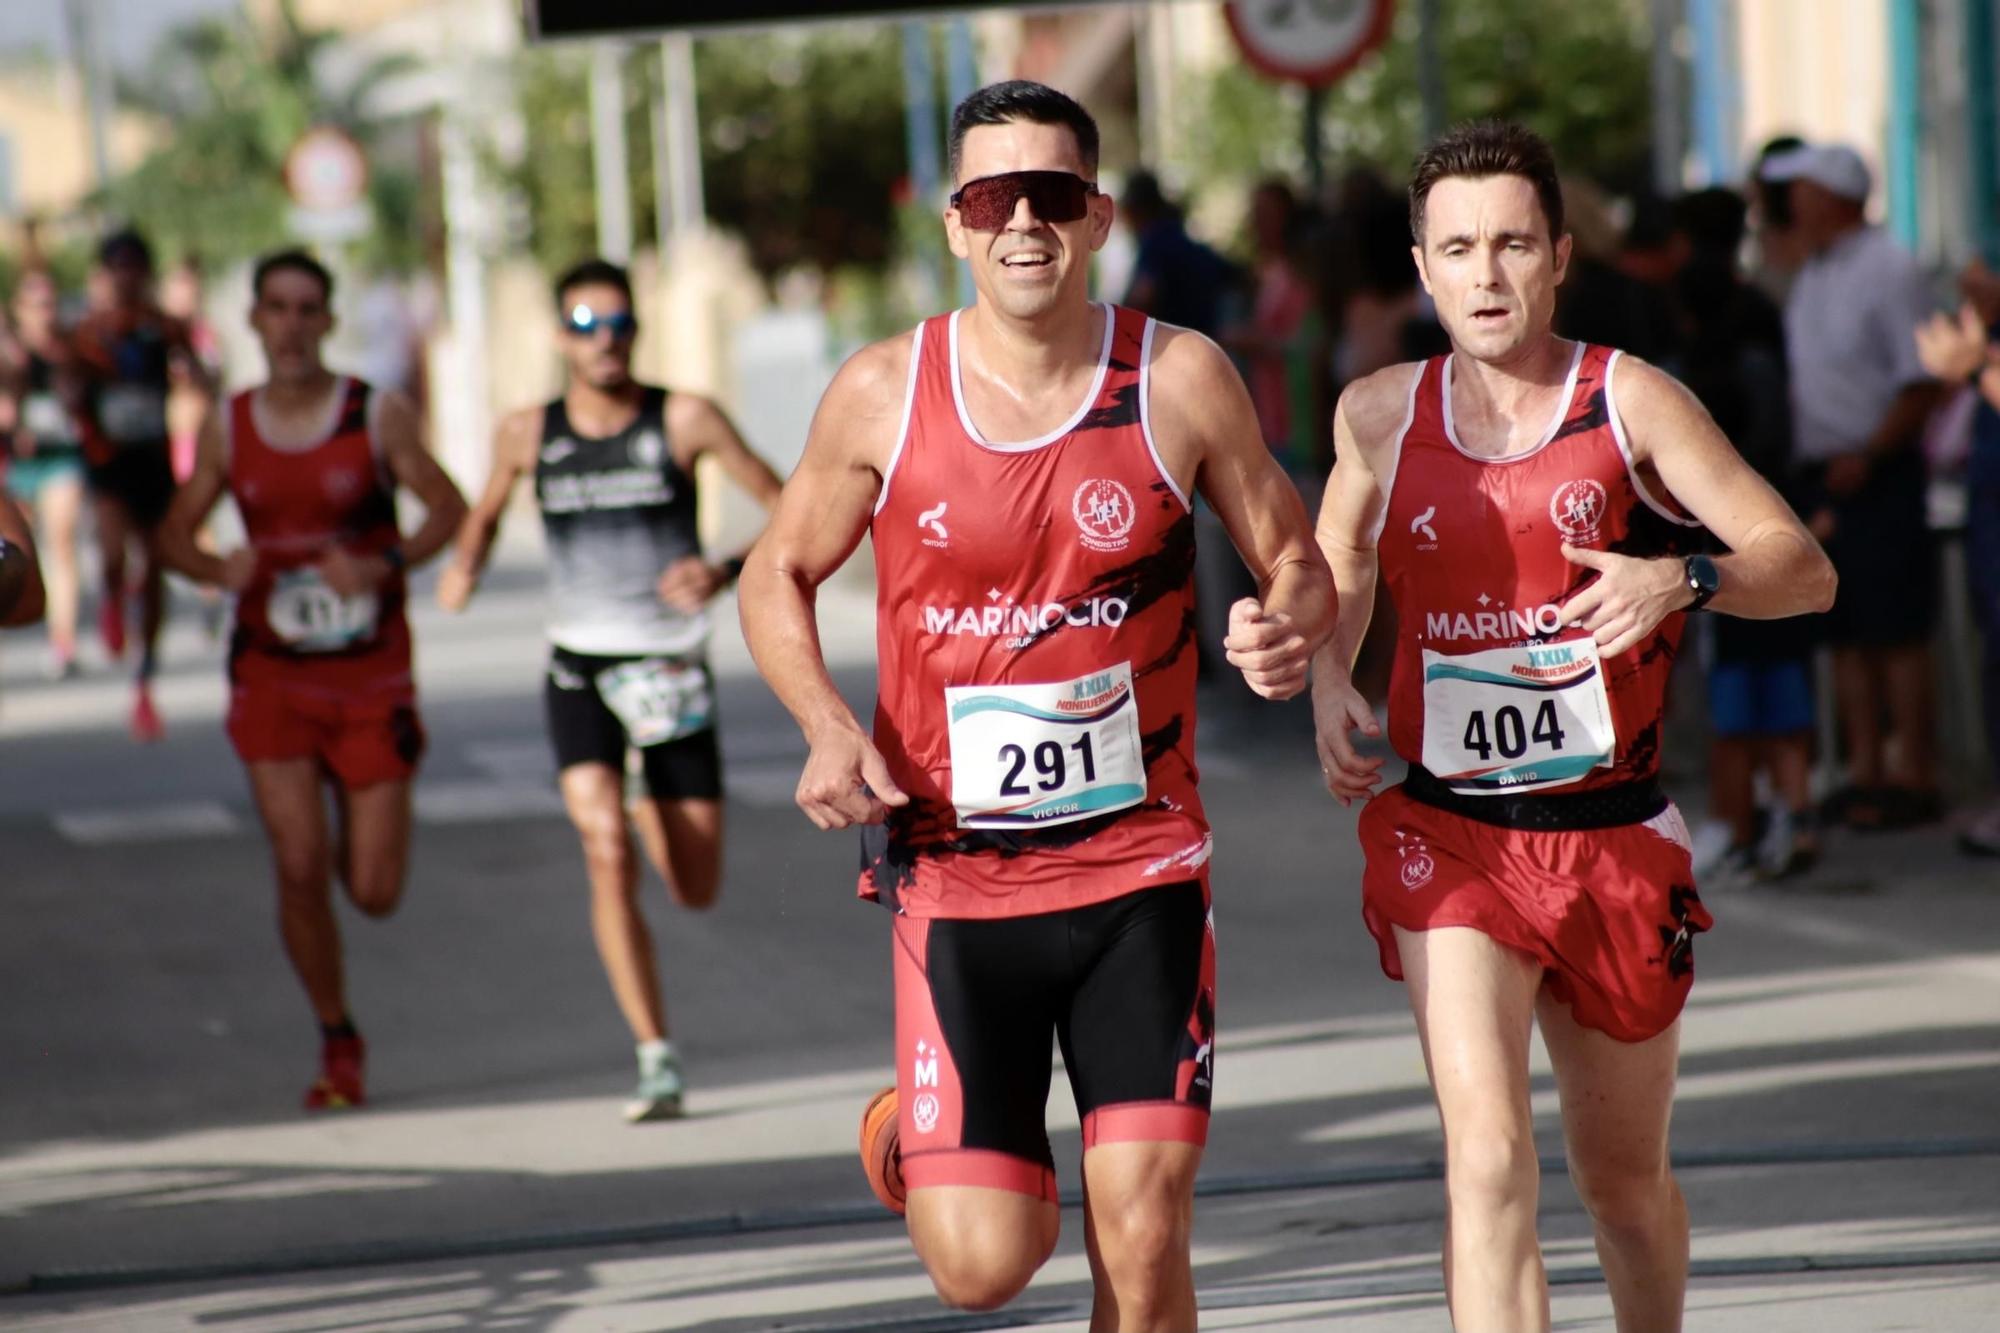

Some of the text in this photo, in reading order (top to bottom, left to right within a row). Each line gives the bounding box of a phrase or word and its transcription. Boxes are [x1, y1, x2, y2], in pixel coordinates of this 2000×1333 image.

[925, 597, 1129, 636] MARINOCIO
[1427, 602, 1583, 641] MARINO
[1528, 647, 1573, 667] XXIX
[1073, 672, 1112, 700] XXIX
[1463, 699, 1565, 761] 404
[998, 731, 1096, 797] 291
[1498, 772, 1538, 785] DAVID
[1032, 802, 1080, 820] VICTOR
[915, 1059, 938, 1088] M
